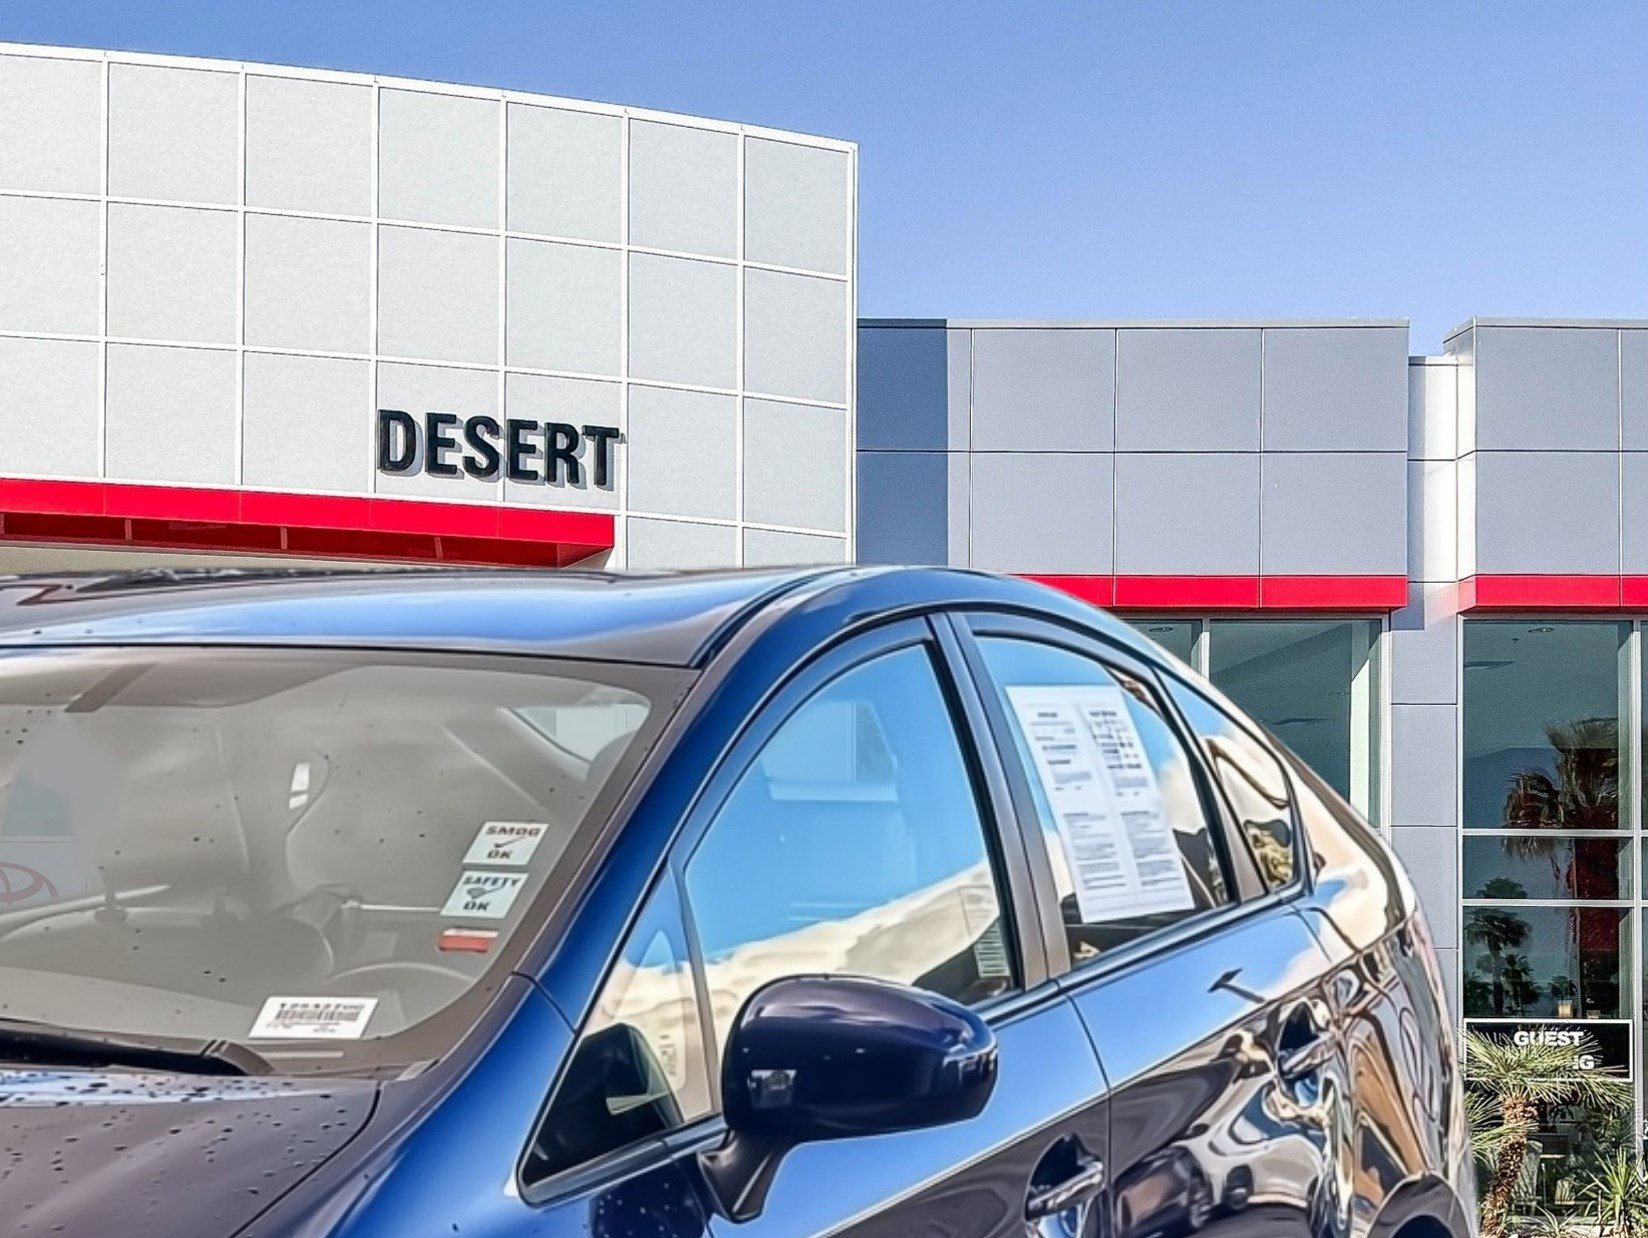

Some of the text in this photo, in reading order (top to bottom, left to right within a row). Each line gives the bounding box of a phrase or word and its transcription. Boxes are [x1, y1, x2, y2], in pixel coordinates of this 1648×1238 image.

[377, 409, 620, 487] DESERT
[486, 826, 541, 836] SMOG
[487, 849, 512, 859] OK
[463, 876, 522, 887] SAFETY
[463, 900, 490, 911] OK
[1513, 1030, 1585, 1047] GUEST
